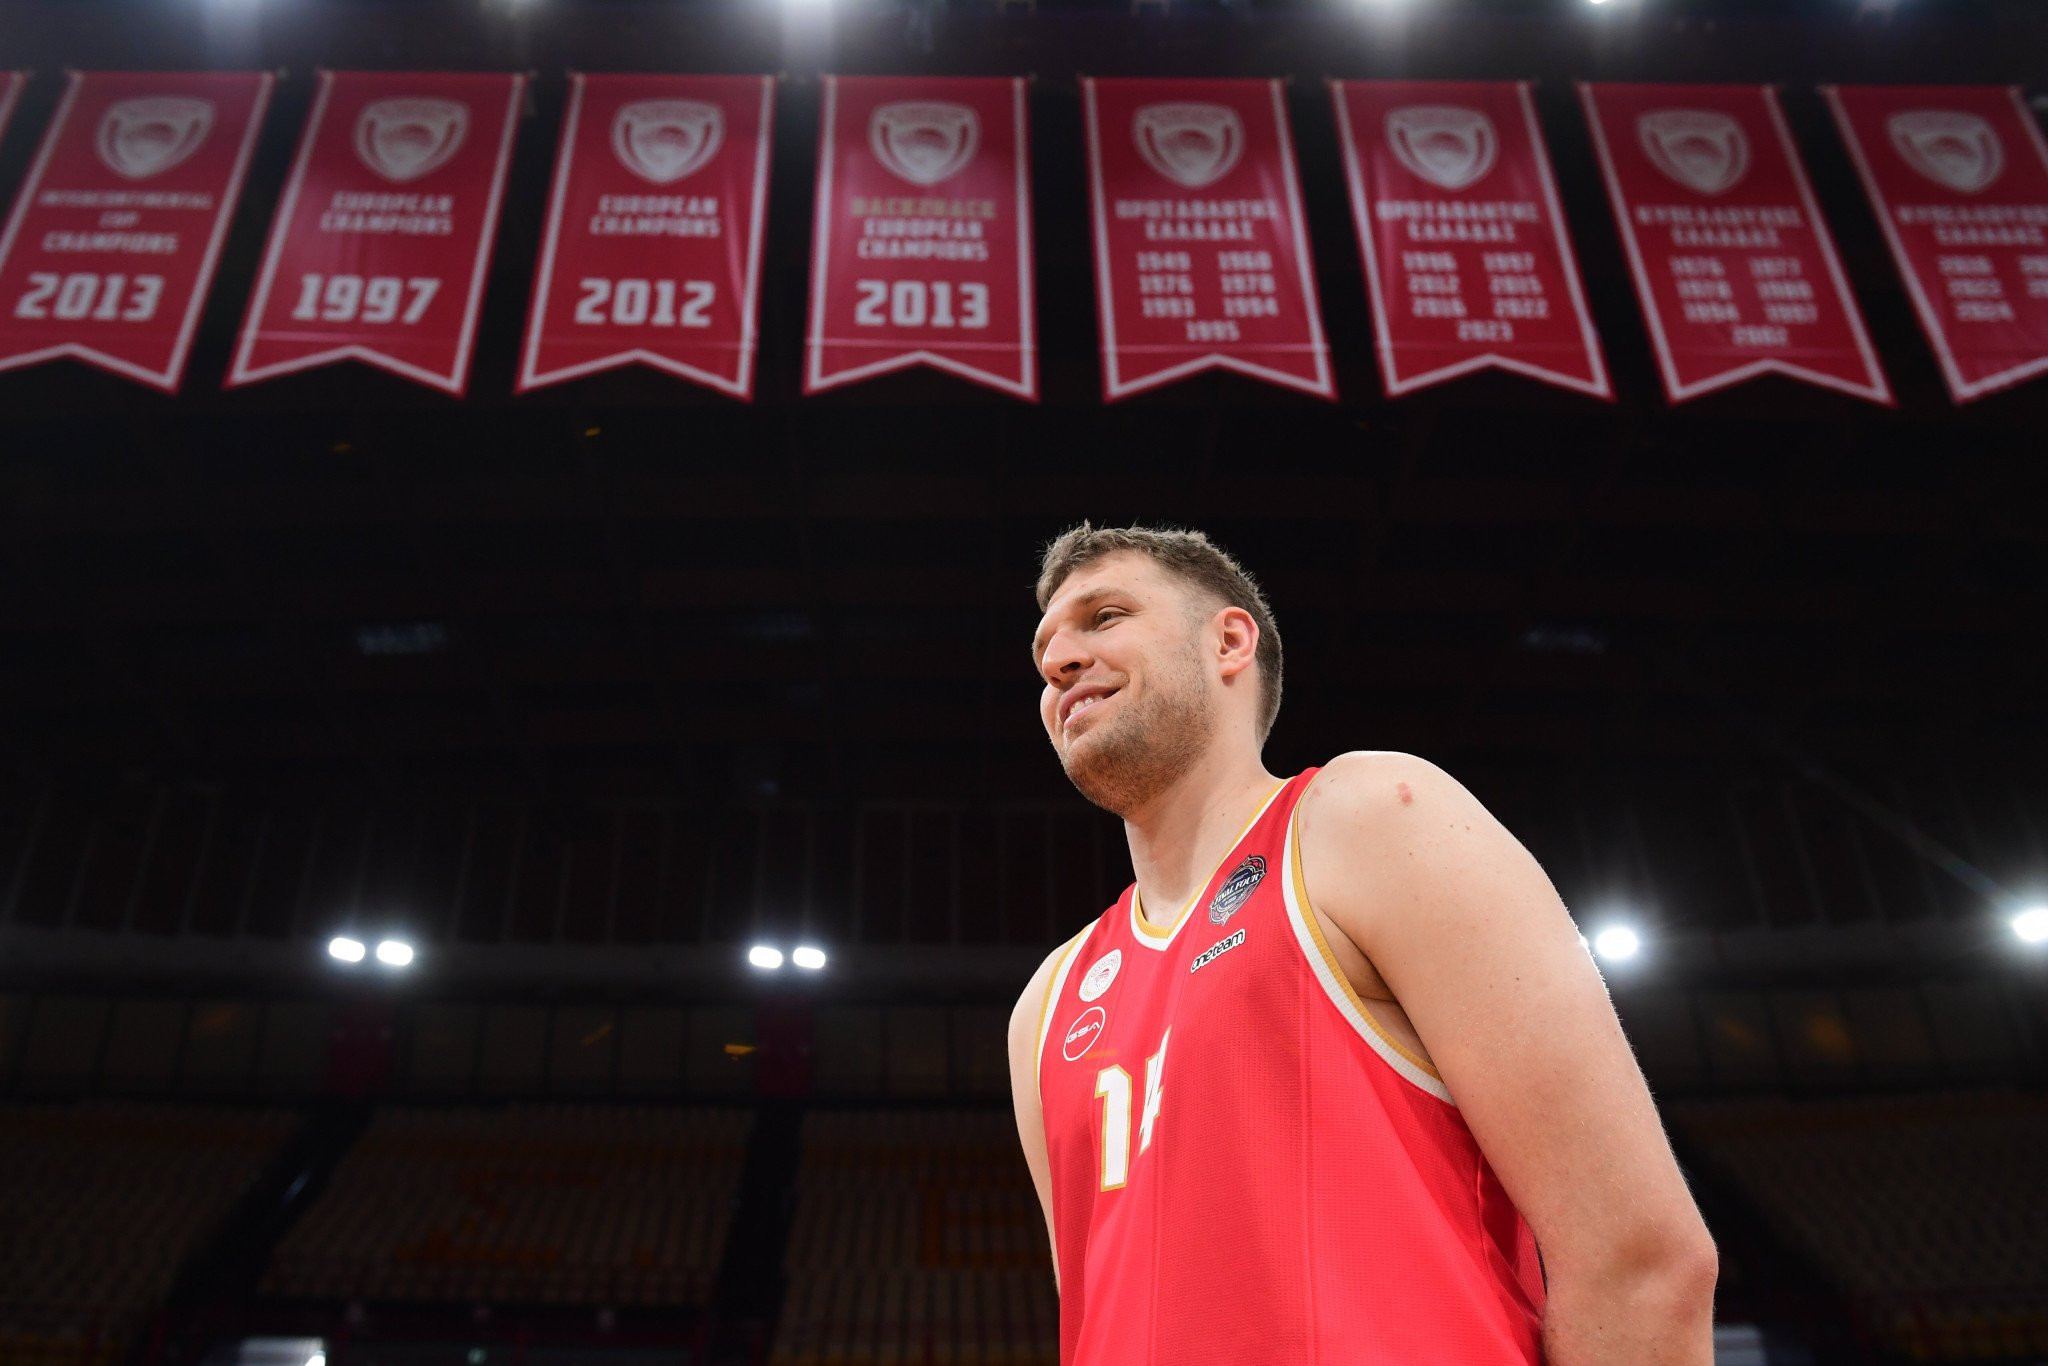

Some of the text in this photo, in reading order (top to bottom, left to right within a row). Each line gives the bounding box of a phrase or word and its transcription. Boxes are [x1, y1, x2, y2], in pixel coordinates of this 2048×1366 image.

[327, 193, 452, 212] EUROPEAN
[600, 197, 717, 216] EUROPEAN
[320, 213, 451, 232] CHAMPIONS
[591, 217, 719, 235] CHAMPIONS
[865, 219, 981, 237] EUROPEAN
[44, 233, 177, 252] CHAMPIONS
[858, 240, 987, 259] CHAMPIONS
[16, 274, 163, 320] 2013
[293, 275, 439, 322] 1997
[576, 279, 715, 326] 2012
[856, 280, 988, 327] 2013
[1066, 1021, 1100, 1043] GSA
